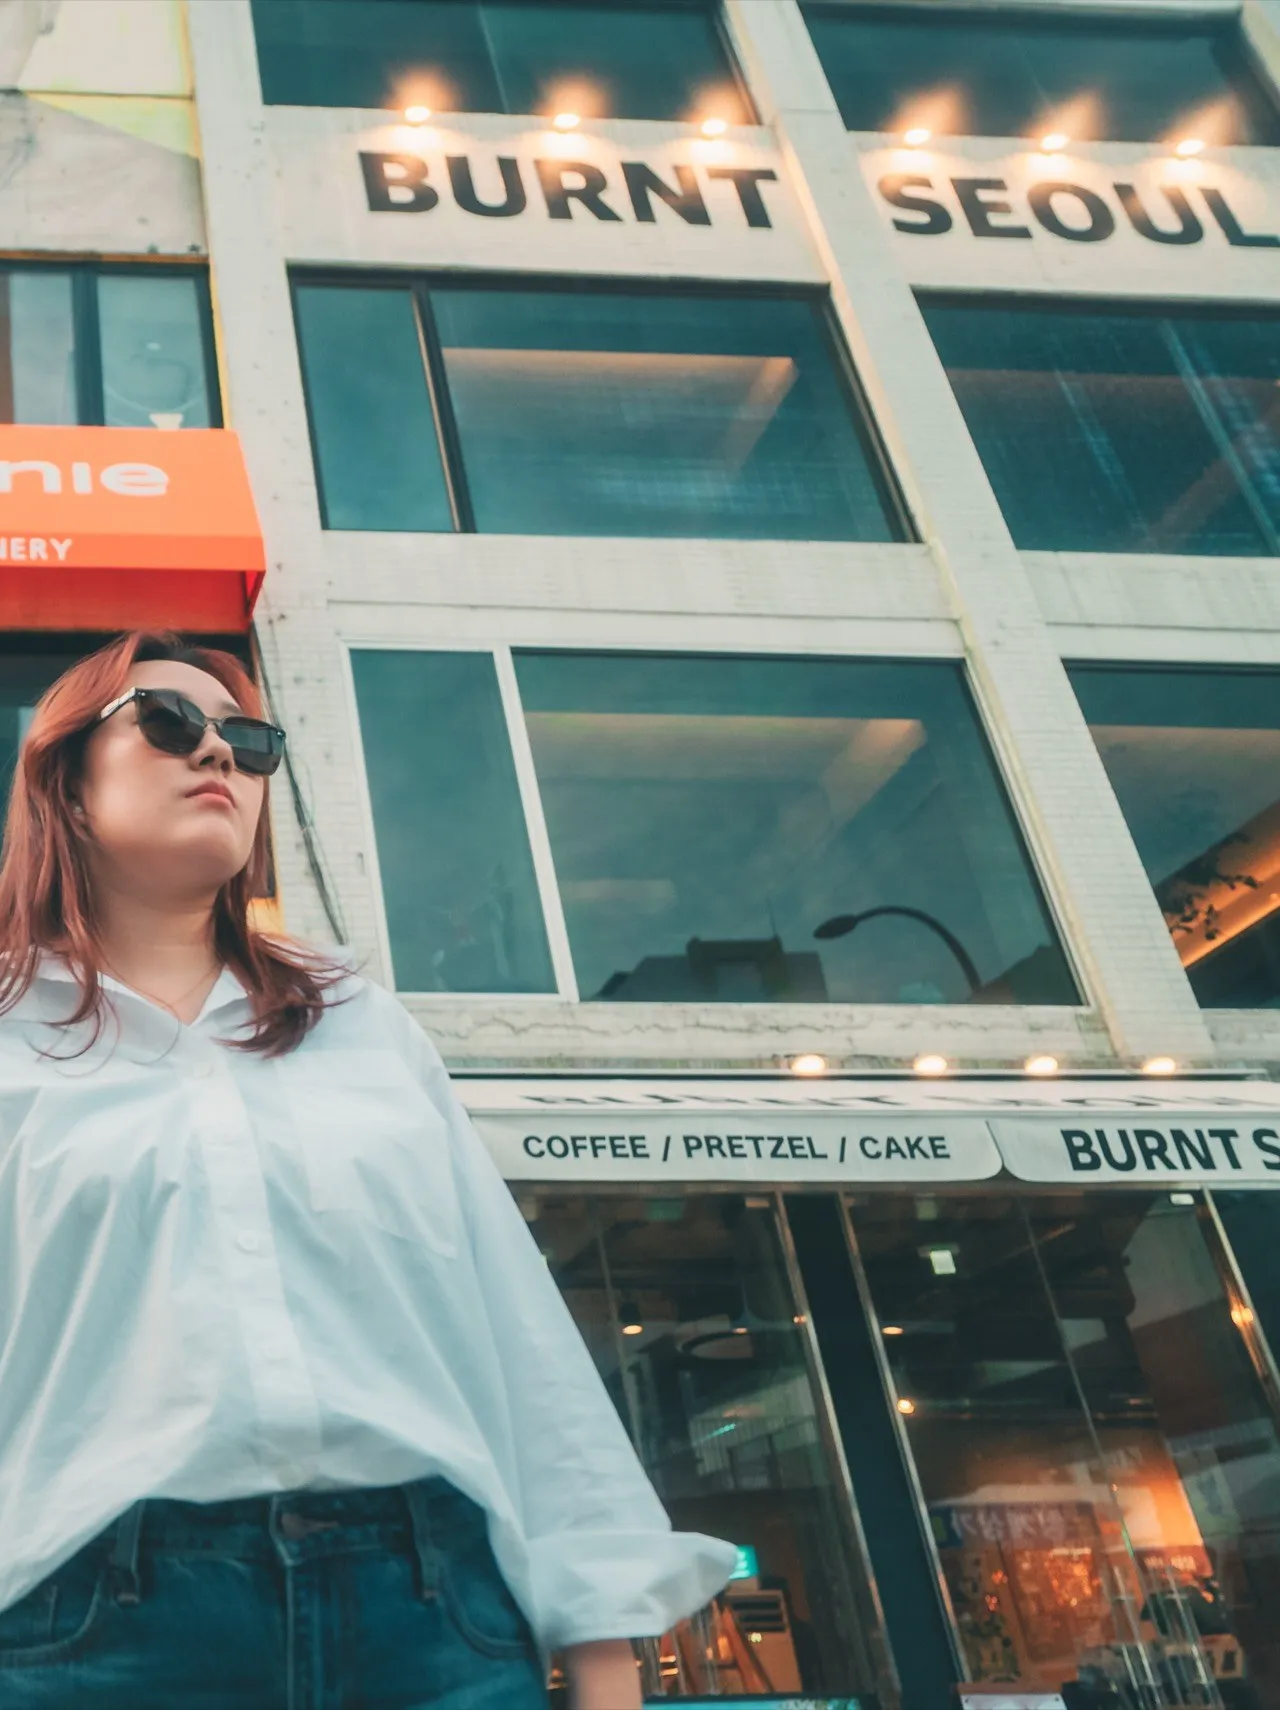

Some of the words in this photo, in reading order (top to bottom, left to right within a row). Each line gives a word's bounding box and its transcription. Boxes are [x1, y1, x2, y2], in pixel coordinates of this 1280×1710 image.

[358, 151, 778, 229] BURNT
[877, 174, 1280, 248] SEOUL
[522, 1135, 650, 1159] COFFEE
[661, 1136, 671, 1162] /
[683, 1135, 828, 1159] PRETZEL
[839, 1136, 847, 1162] /
[860, 1135, 951, 1160] CAKE
[1060, 1129, 1243, 1171] BURNT
